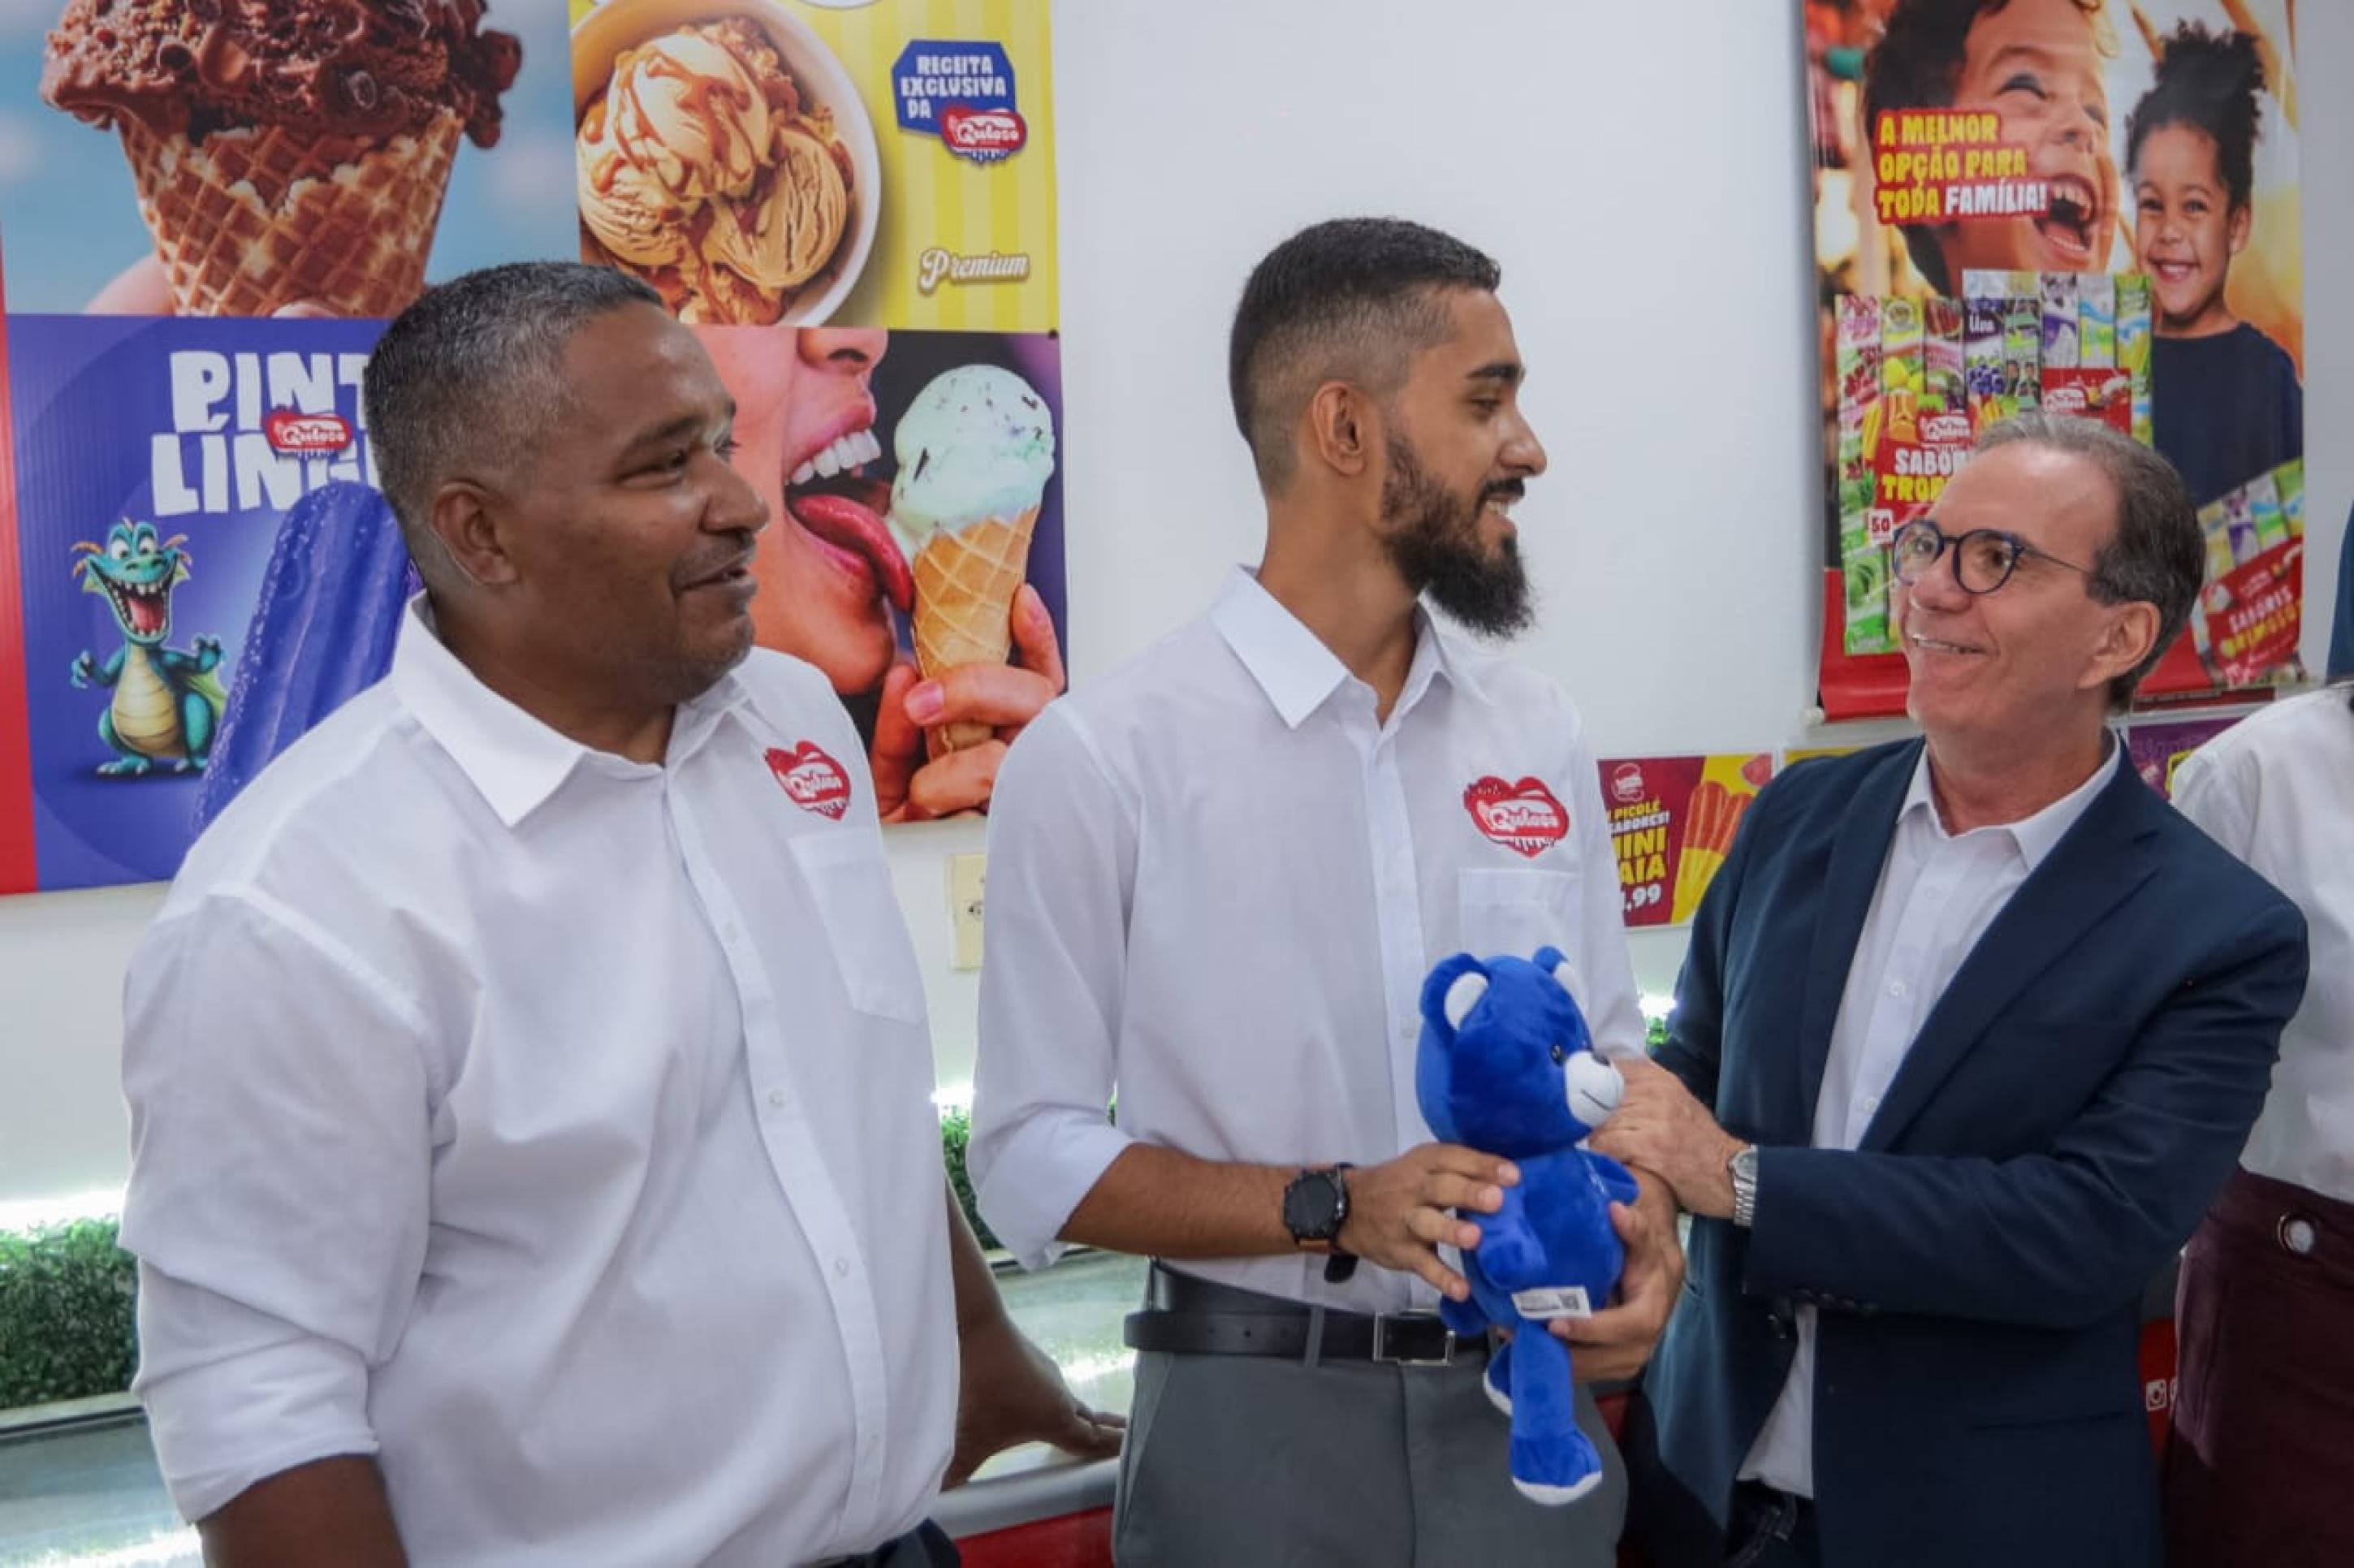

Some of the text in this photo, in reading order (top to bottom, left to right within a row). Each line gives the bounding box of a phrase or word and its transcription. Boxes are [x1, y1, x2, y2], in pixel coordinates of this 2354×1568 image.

[901, 76, 1007, 98] EXCLUSIVA
[907, 98, 931, 119] DA
[1881, 113, 1998, 145] A MELHOR
[1965, 148, 2028, 178] PARA
[1878, 178, 2049, 219] TODA FAMÍLIA!
[918, 248, 1030, 292] Premium
